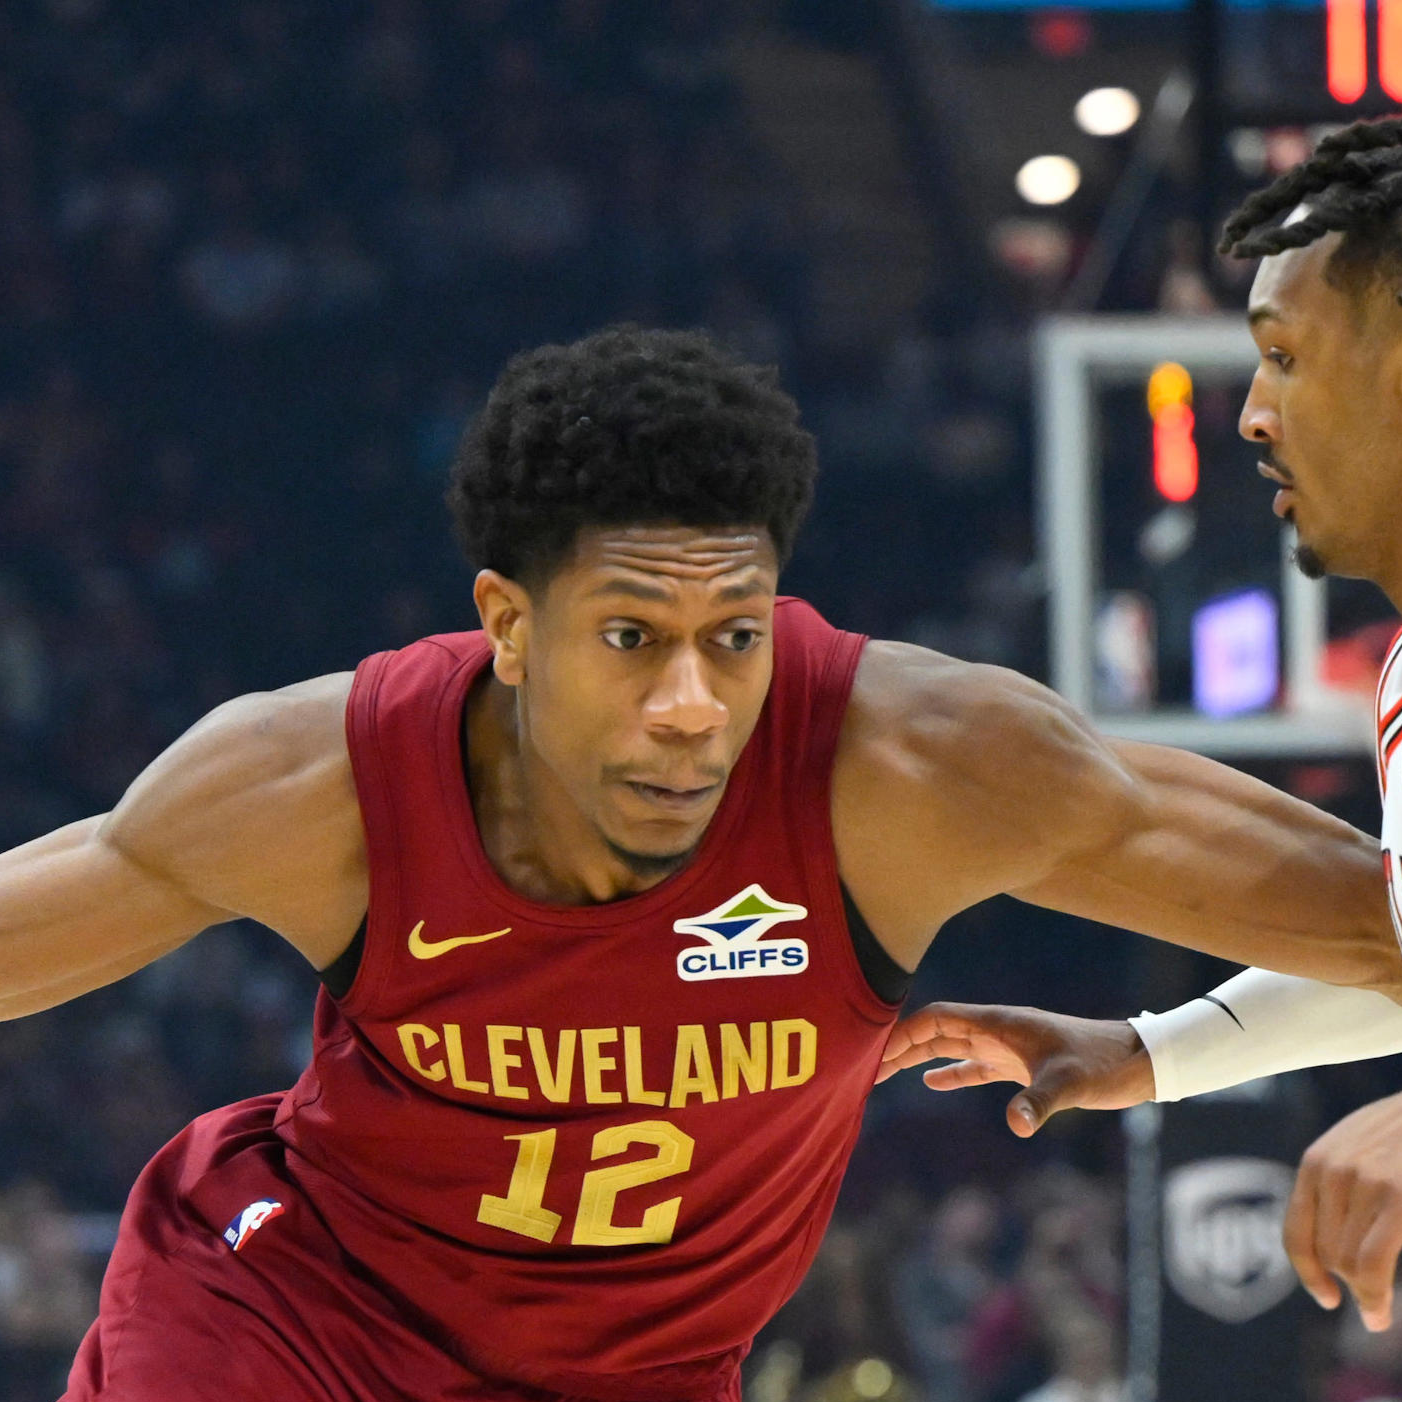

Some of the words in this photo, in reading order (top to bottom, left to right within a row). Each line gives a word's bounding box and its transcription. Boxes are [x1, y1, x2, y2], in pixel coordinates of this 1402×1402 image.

[682, 946, 805, 974] CLIFFS
[396, 1018, 818, 1109] CLEVELAND
[476, 1120, 695, 1246] 12
